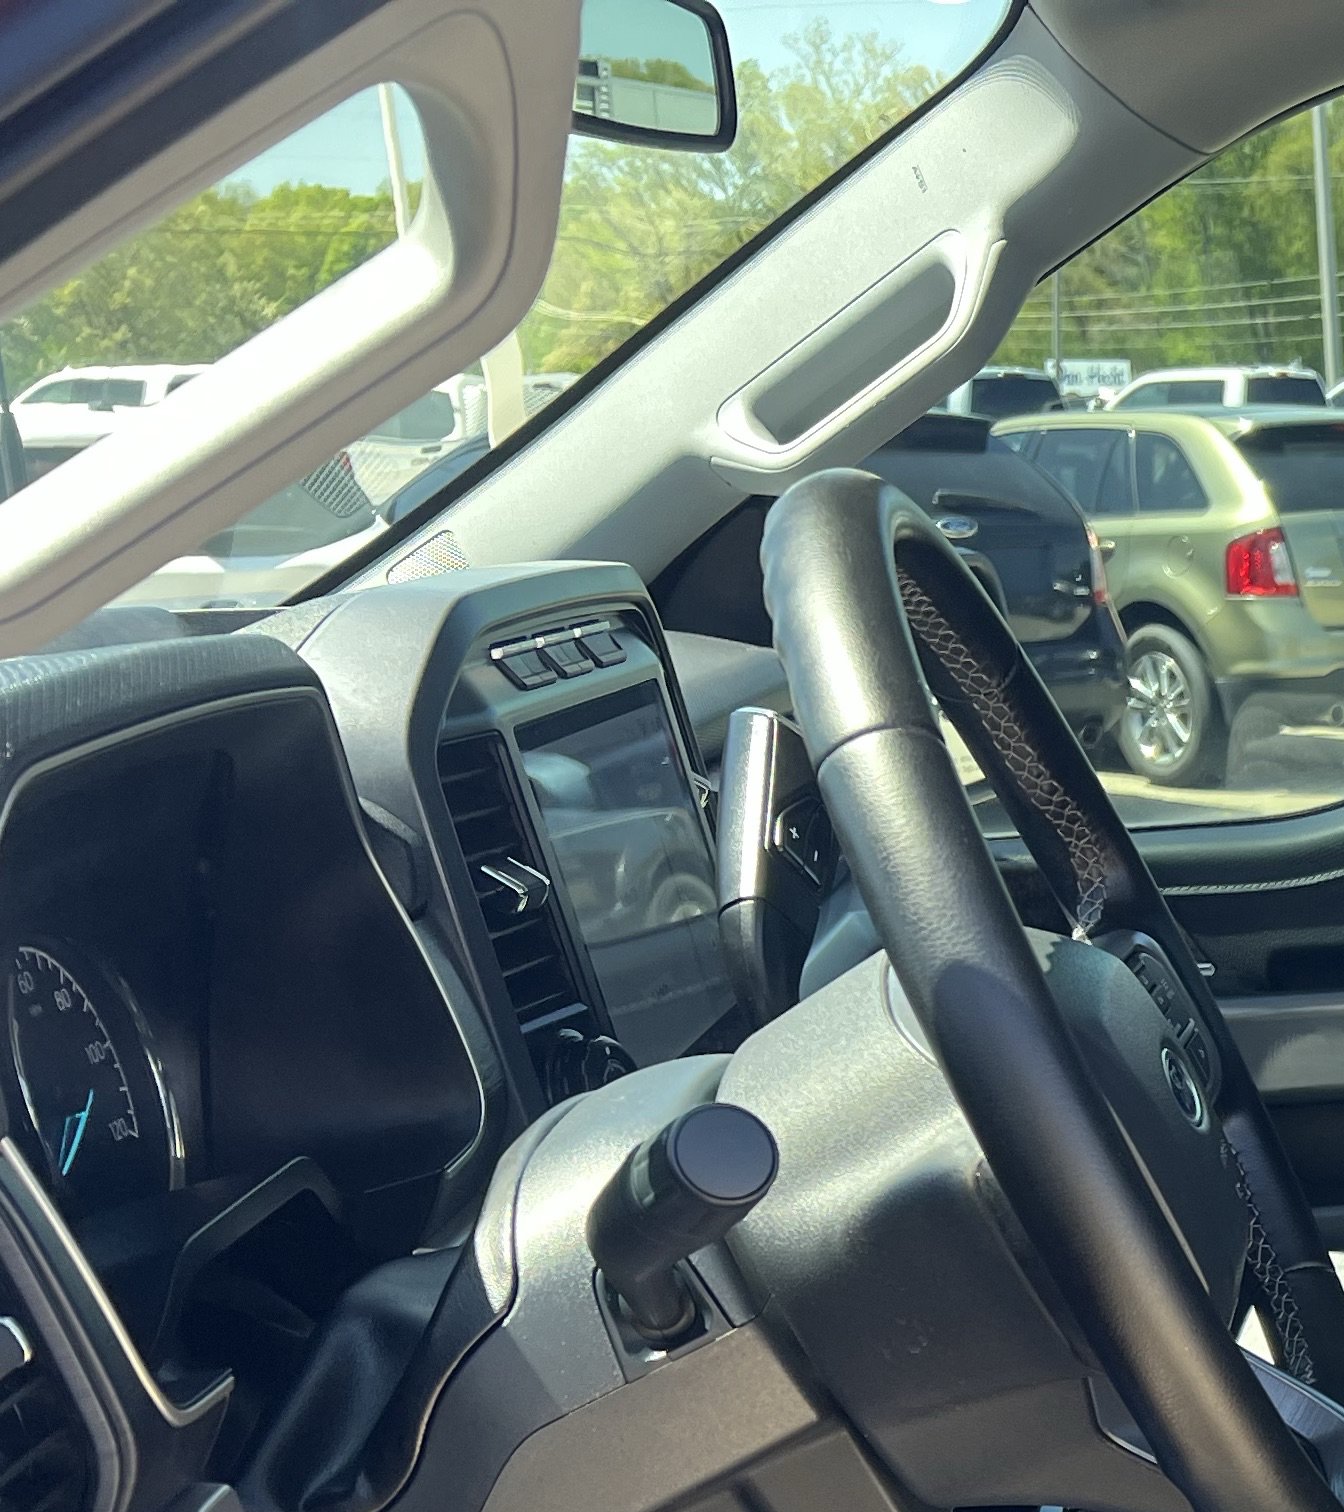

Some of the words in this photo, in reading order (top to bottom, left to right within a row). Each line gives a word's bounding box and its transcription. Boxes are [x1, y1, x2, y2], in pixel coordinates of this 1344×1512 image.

[17, 971, 34, 994] 60
[54, 988, 72, 1011] 80
[84, 1040, 105, 1064] 100
[108, 1117, 128, 1141] 120
